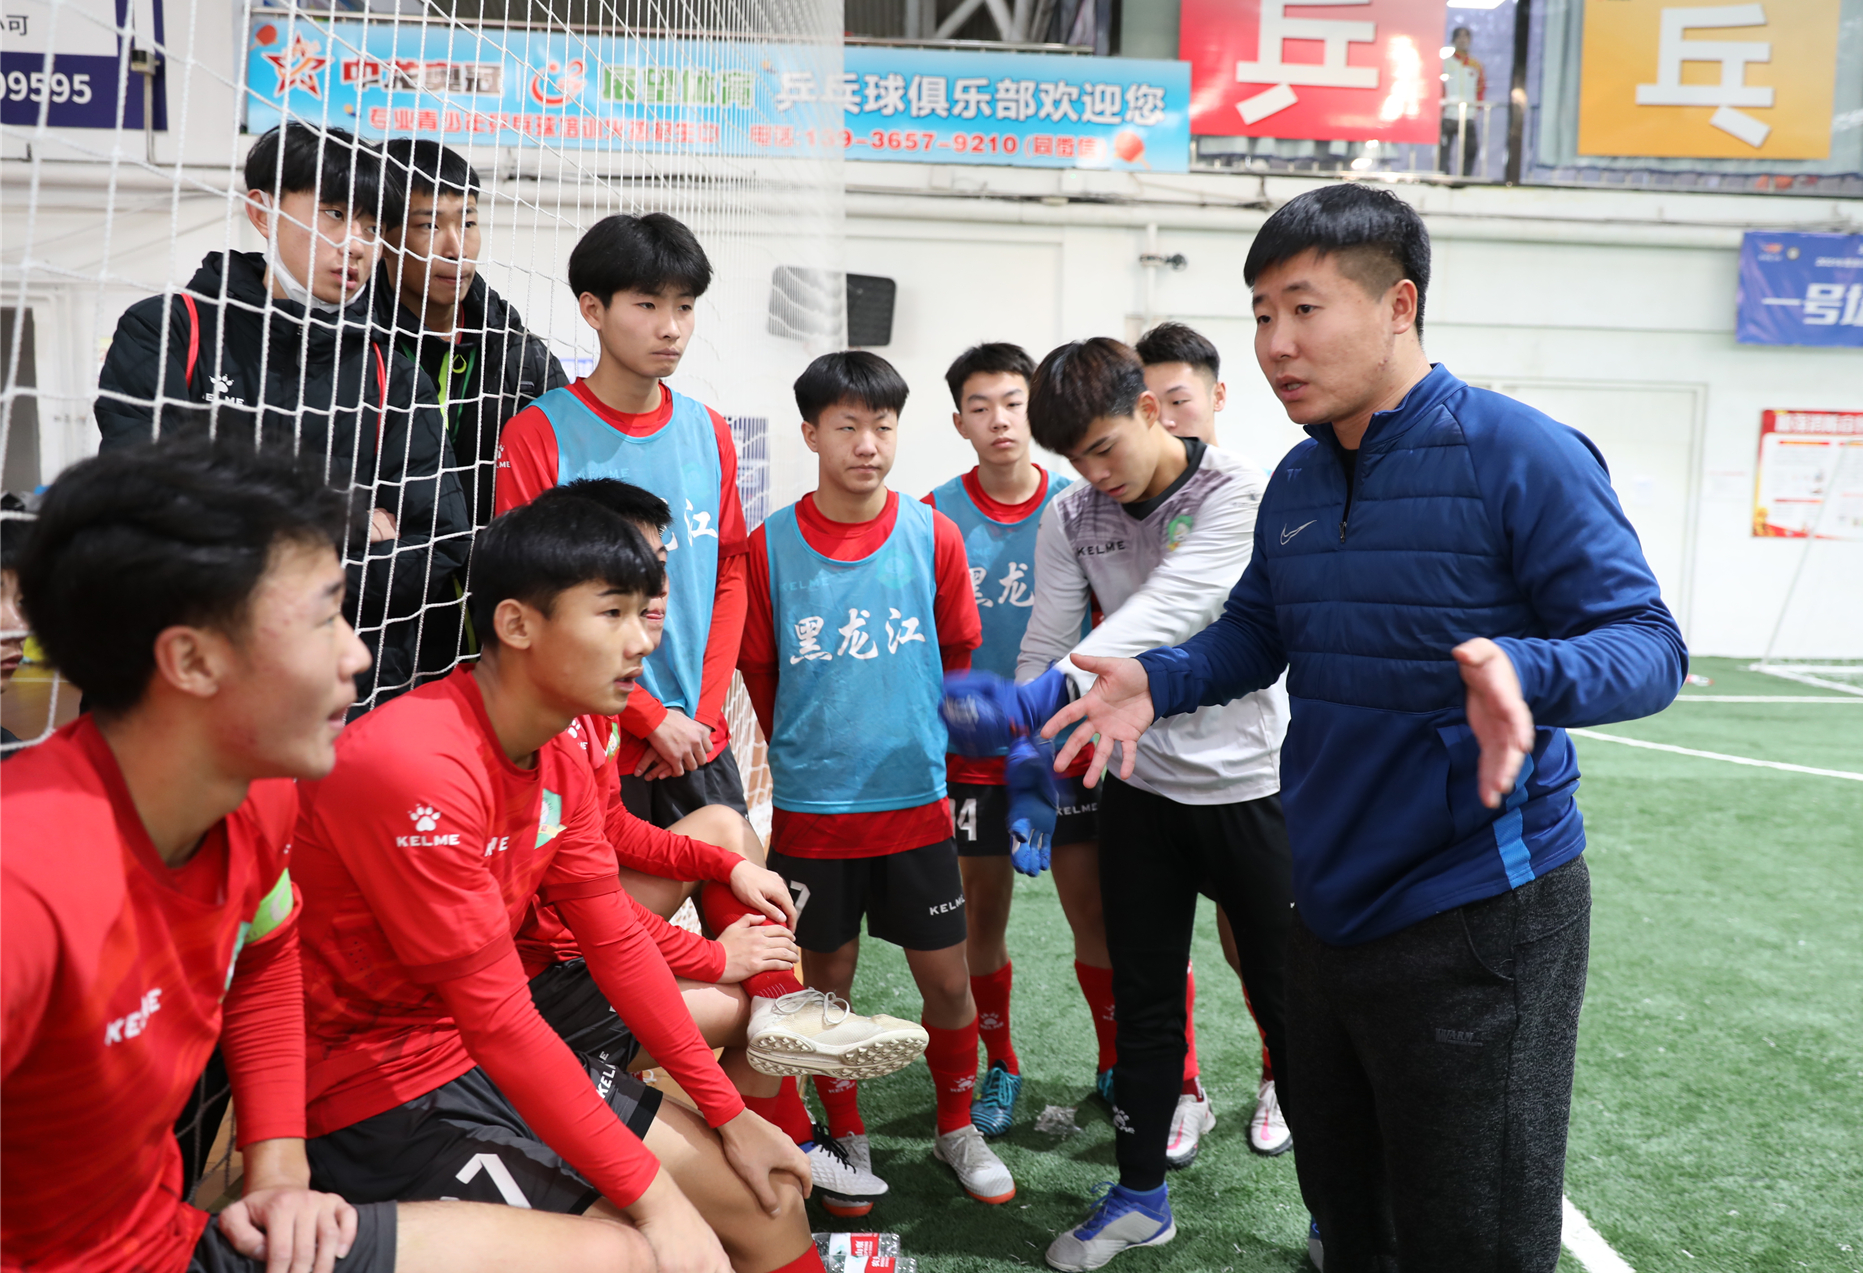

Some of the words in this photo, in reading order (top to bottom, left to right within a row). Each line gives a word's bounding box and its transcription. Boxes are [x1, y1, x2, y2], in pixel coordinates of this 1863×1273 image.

[0, 14, 29, 36] 可
[1635, 2, 1776, 149] 乓
[776, 71, 1166, 127] 乒乓球俱乐部欢迎您
[1077, 540, 1126, 556] KELME
[789, 607, 926, 665] 黑龙江
[396, 833, 461, 848] KELME
